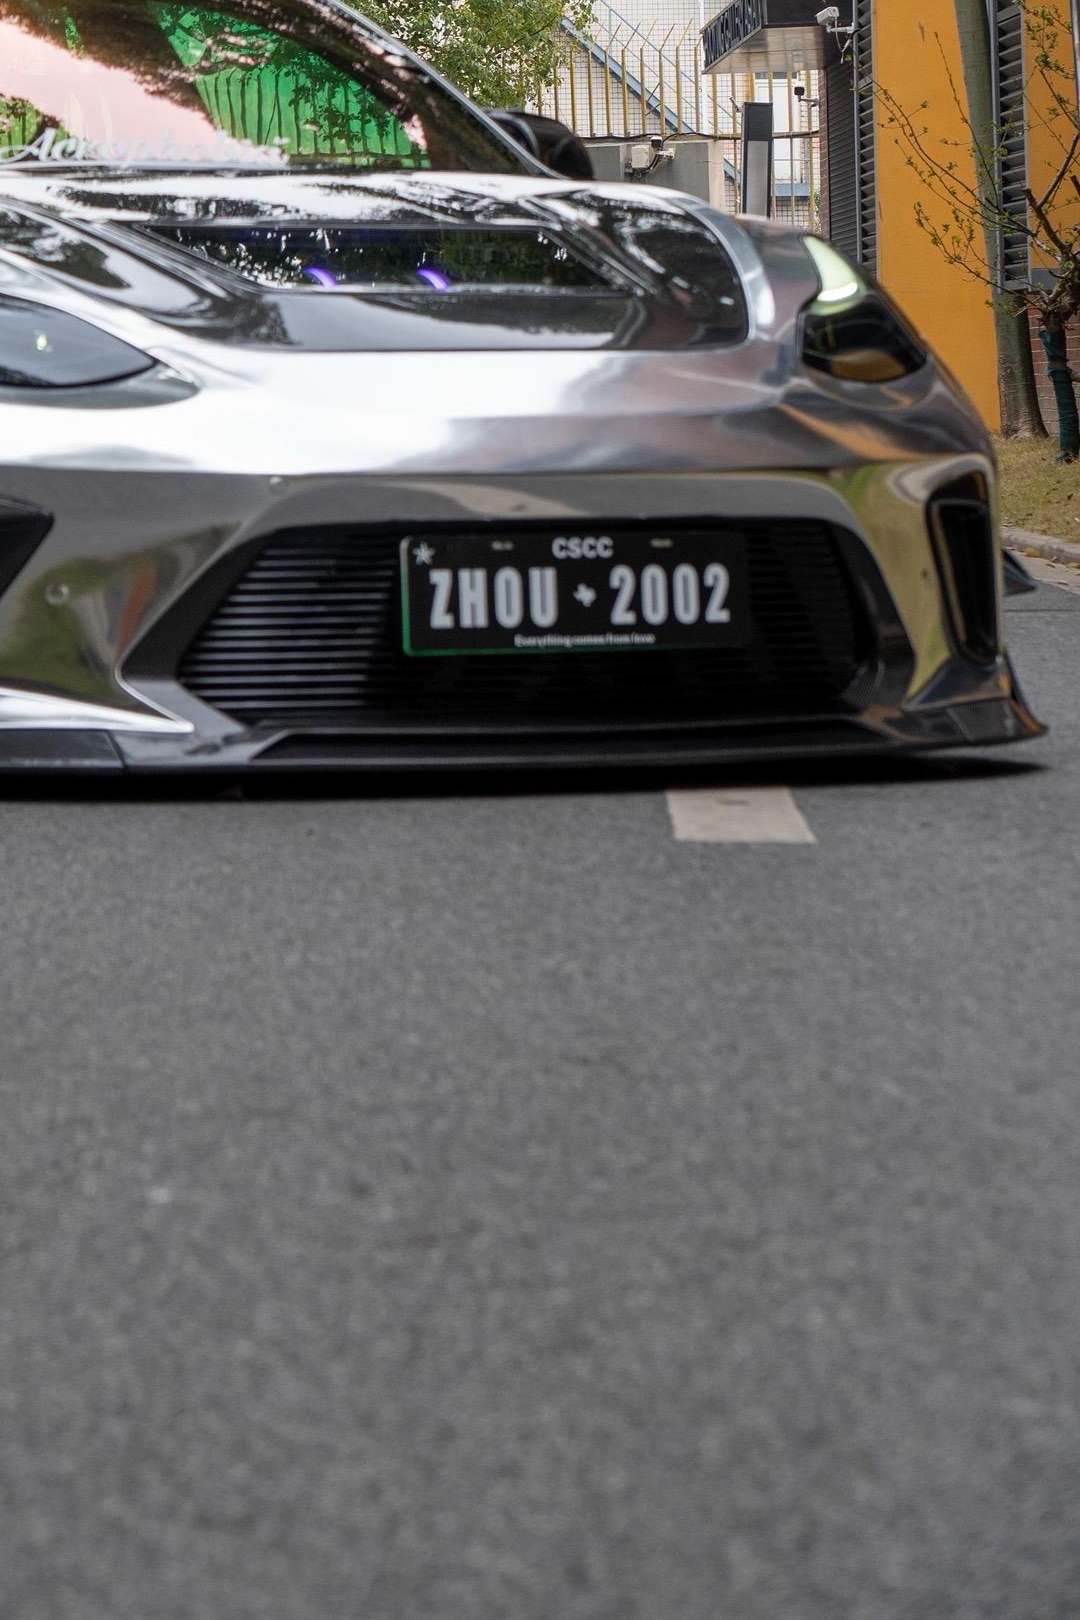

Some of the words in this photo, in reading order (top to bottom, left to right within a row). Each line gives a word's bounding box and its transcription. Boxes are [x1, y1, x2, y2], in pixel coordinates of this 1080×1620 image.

[551, 536, 614, 559] CSCC
[428, 566, 558, 629] ZHOU
[609, 563, 731, 626] 2002
